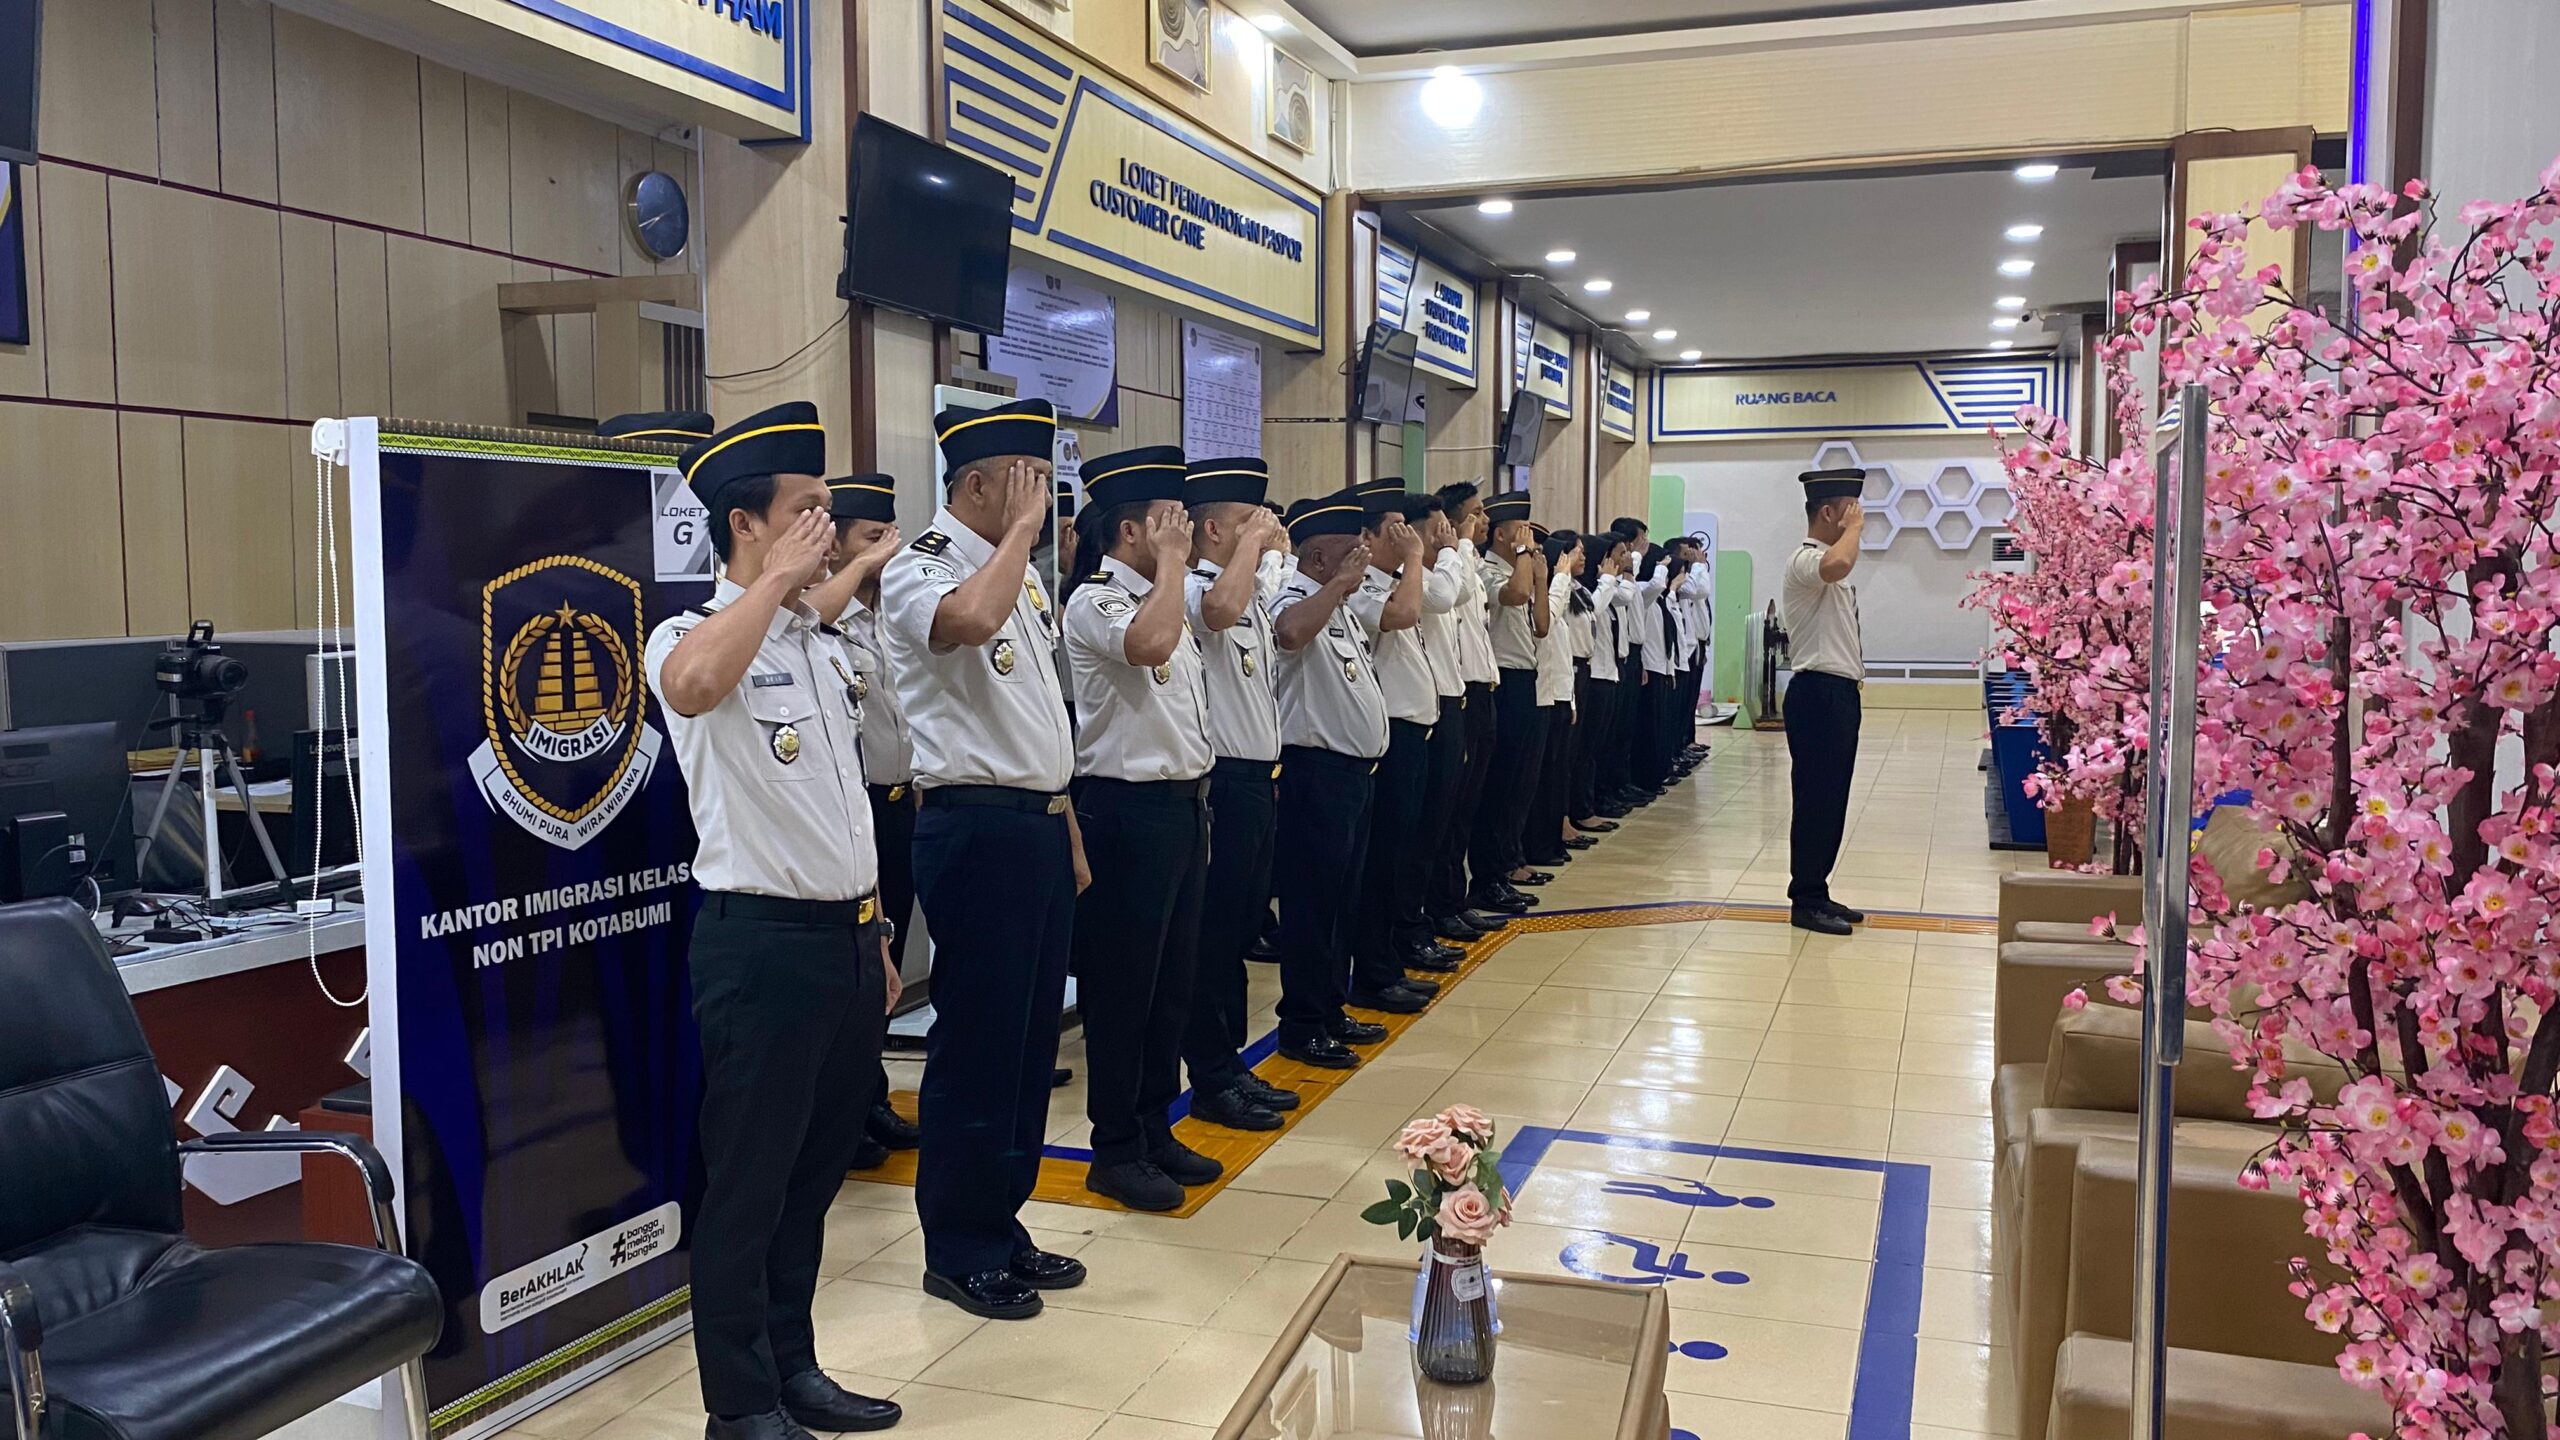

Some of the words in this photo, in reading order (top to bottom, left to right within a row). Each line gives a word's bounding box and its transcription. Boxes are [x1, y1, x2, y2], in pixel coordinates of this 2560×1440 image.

[1089, 179, 1169, 235] CUSTOMER
[1170, 214, 1205, 250] CARE
[1120, 157, 1169, 201] LOKET
[1170, 181, 1260, 246] PERMOHONAN
[1261, 225, 1303, 262] PASPOR
[1735, 392, 1791, 406] RUANG
[1793, 391, 1837, 404] BACA
[660, 507, 705, 517] LOKET
[673, 521, 694, 545] G
[529, 721, 610, 758] IMIGRASI
[502, 789, 537, 827] BHUMI
[538, 819, 569, 841] PURA
[577, 812, 606, 838] WIRA
[604, 767, 640, 815] WIBAWA
[421, 897, 518, 939] KANTOR
[525, 875, 624, 917] IMIGRASI
[629, 861, 691, 894] KELAS
[473, 935, 523, 969] NON
[528, 926, 563, 955] TPI
[569, 901, 672, 946] KOTABUMI
[626, 1218, 659, 1240] bangga
[626, 1225, 665, 1250] melayani
[626, 1240, 658, 1261] bangsa
[500, 1256, 585, 1308] BerAKHLAK
